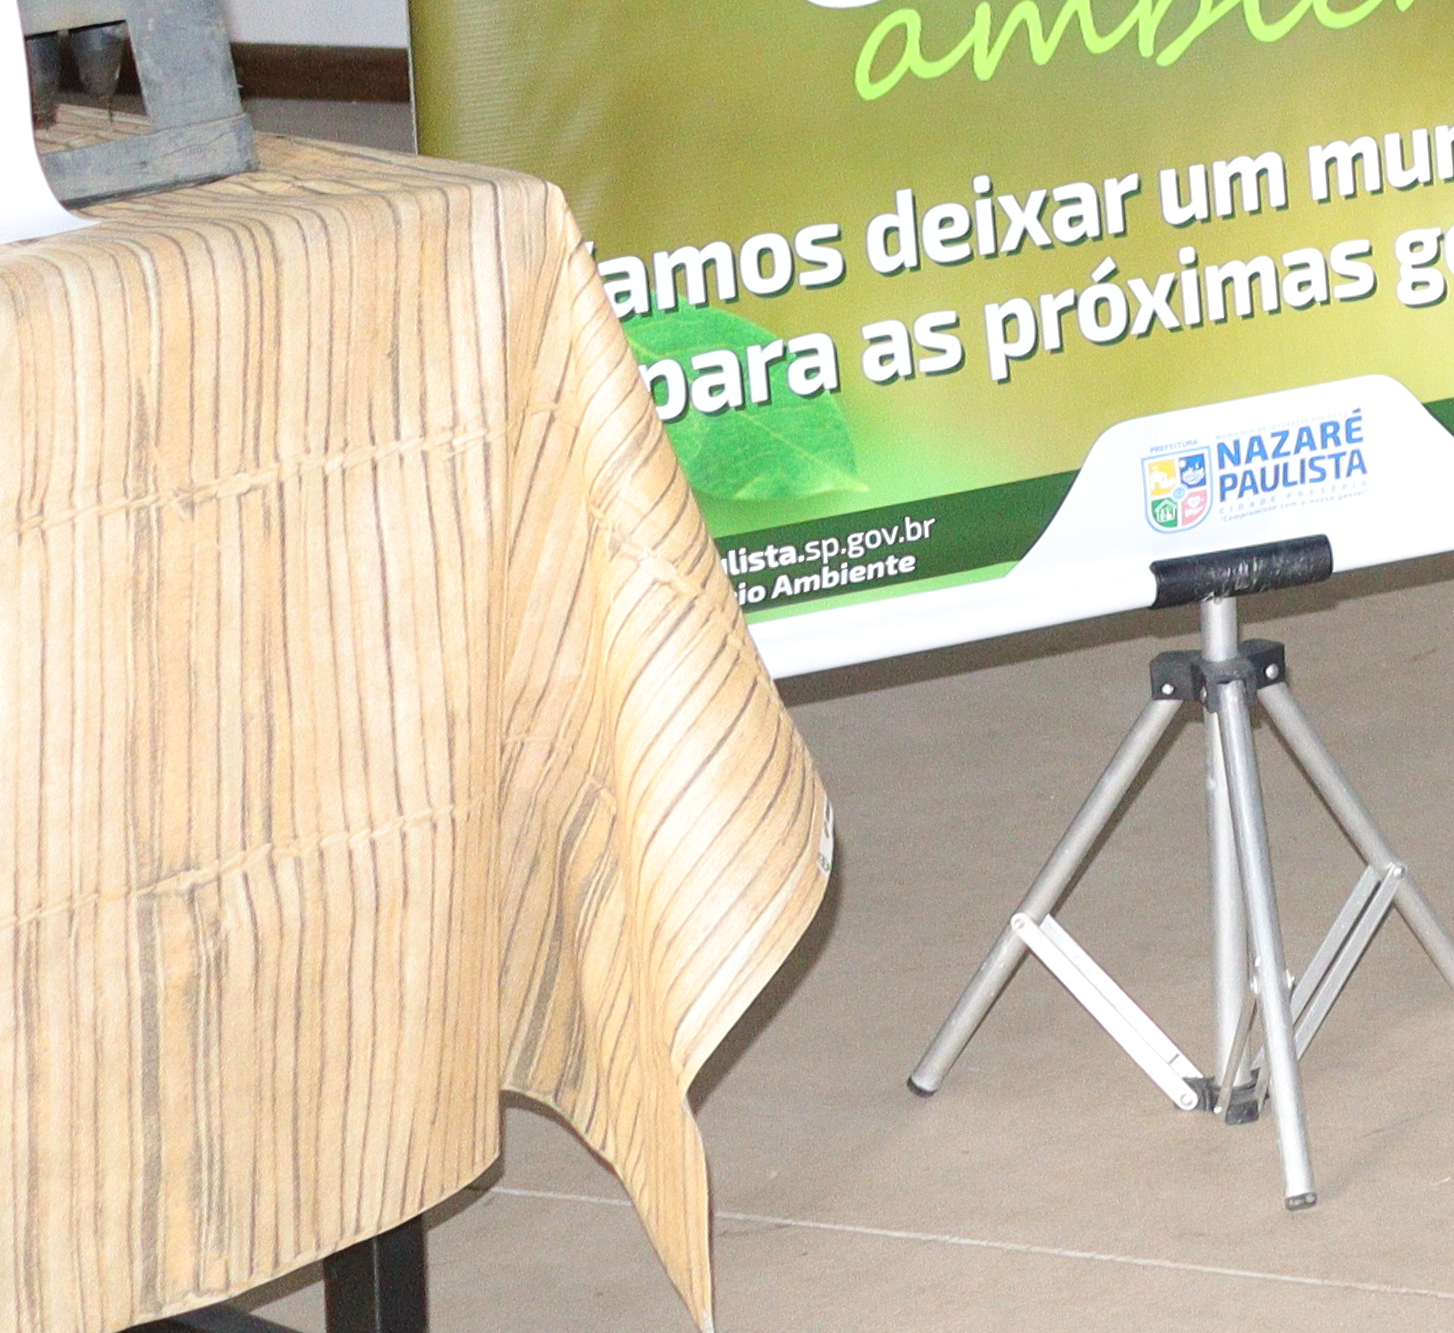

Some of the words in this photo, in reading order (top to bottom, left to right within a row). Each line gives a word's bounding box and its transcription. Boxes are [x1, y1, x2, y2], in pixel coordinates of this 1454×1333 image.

[585, 222, 845, 319] amos
[865, 175, 1140, 274] deixar
[1159, 150, 1287, 226] um
[638, 333, 839, 421] para
[861, 310, 964, 383] as
[985, 236, 1375, 381] próximas
[1149, 438, 1199, 454] PREFEITURA
[1216, 407, 1365, 471] NAZARÉ
[1218, 448, 1369, 503] PAULISTA
[1219, 495, 1276, 515] CIDADE
[1286, 479, 1368, 500] PRESÉPIO
[770, 553, 917, 600] Ambiente
